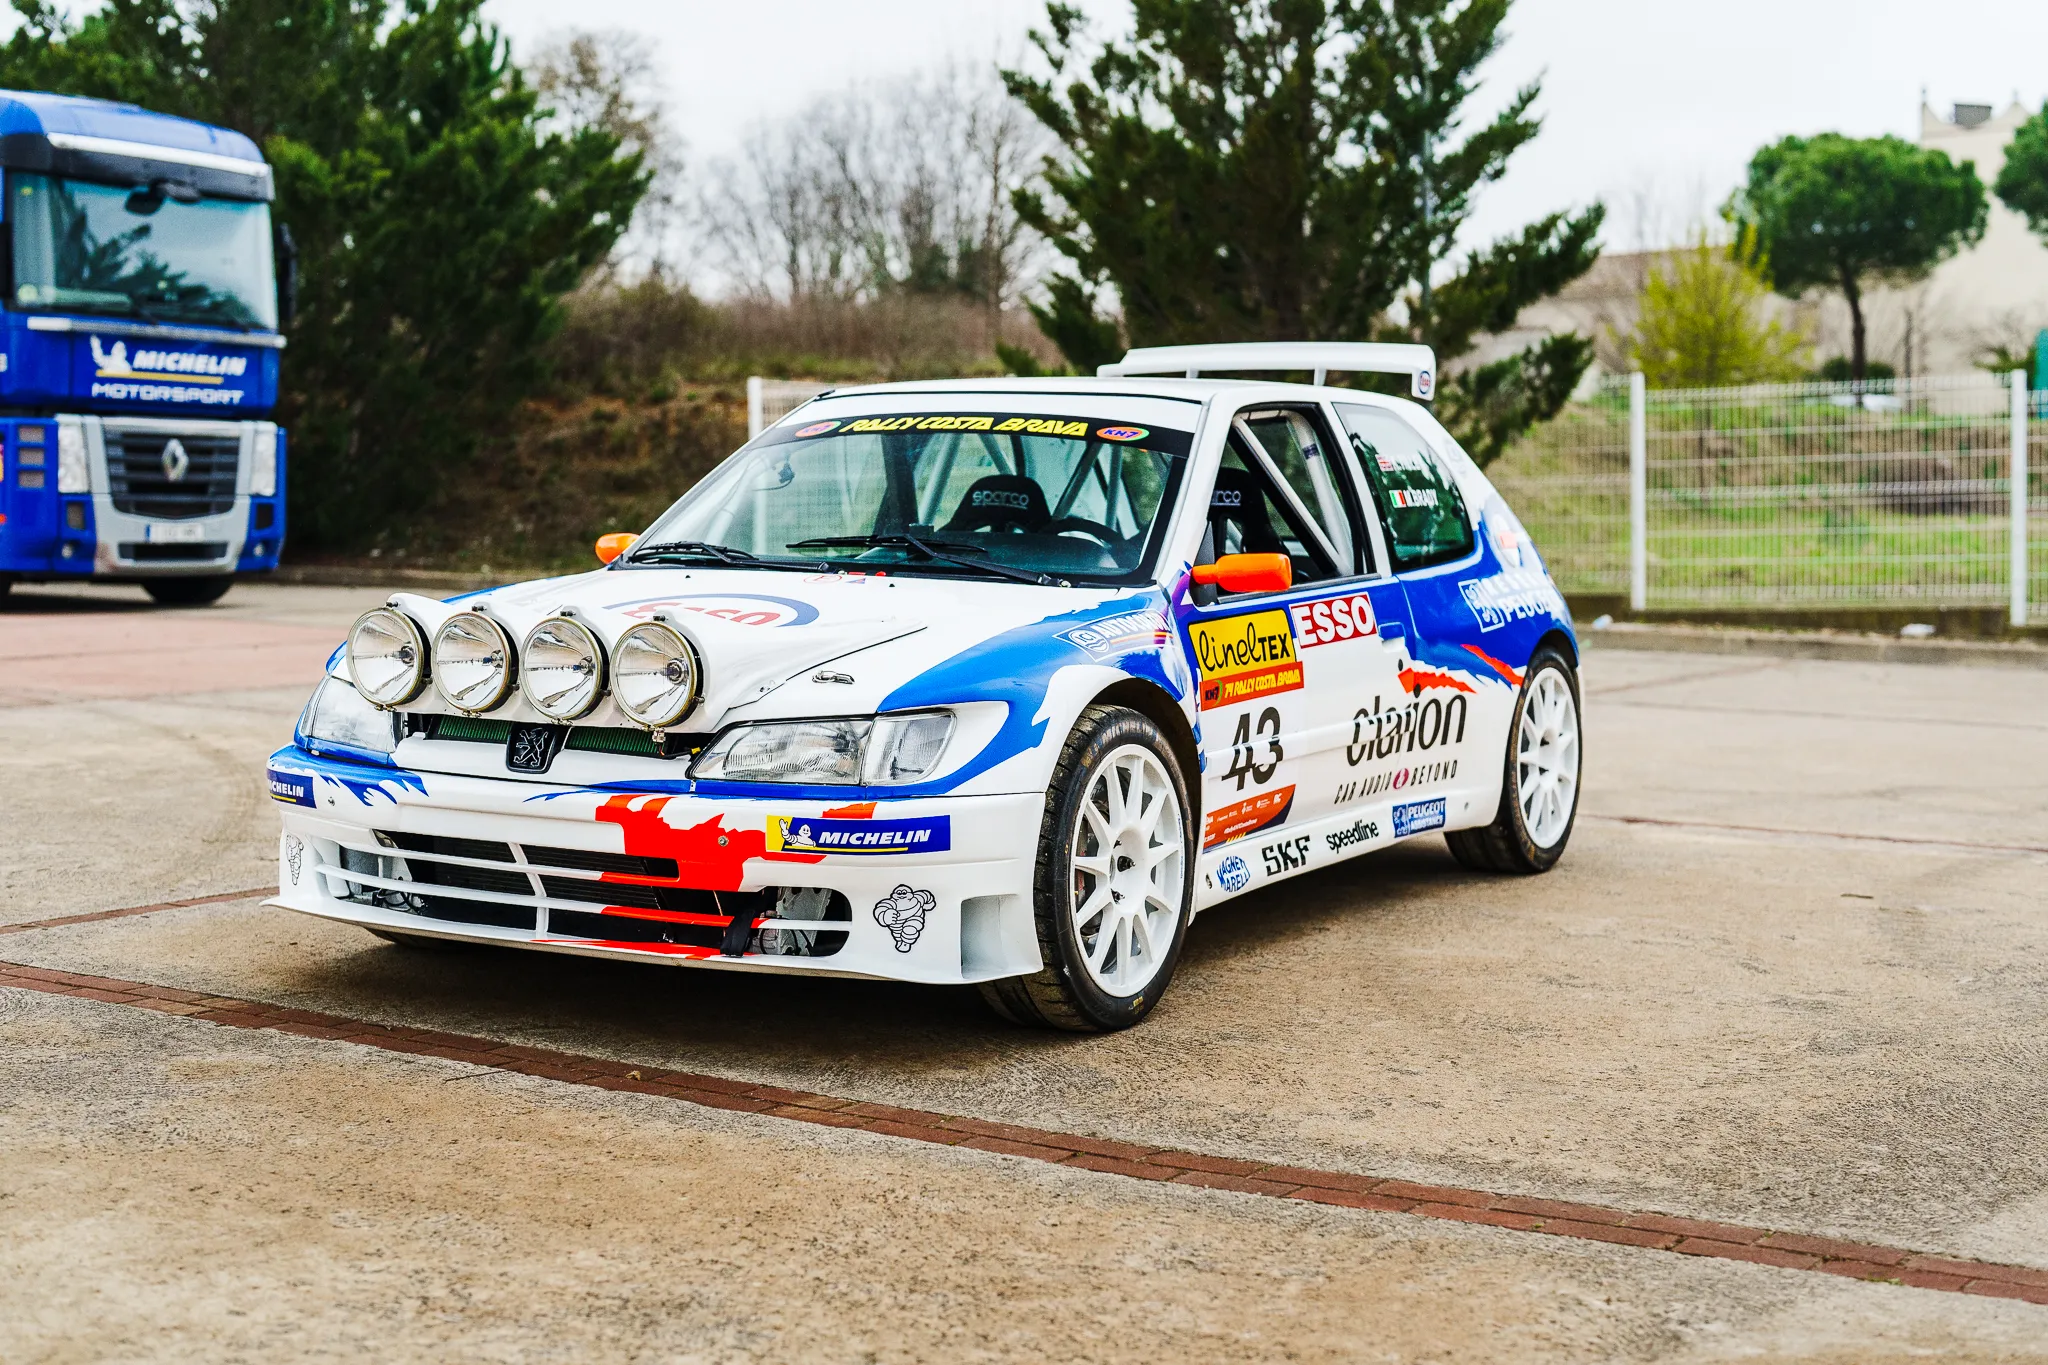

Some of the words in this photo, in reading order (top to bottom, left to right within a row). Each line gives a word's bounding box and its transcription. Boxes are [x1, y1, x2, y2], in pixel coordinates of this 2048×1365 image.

[133, 350, 247, 376] MICHELIN
[91, 382, 244, 405] MOTORSPORT
[839, 417, 924, 432] RALLY
[916, 416, 994, 430] COSTA
[993, 417, 1088, 437] BRAVA
[972, 490, 1029, 506] sparco
[1294, 596, 1376, 646] ESSO
[1233, 677, 1255, 696] RALLY
[1255, 673, 1277, 691] COSTA
[1276, 668, 1301, 686] BRAVA
[1346, 683, 1467, 767] clarion
[1221, 706, 1284, 792] 43
[1334, 781, 1357, 805] CAR
[1359, 771, 1392, 798] AUDIO
[1410, 759, 1458, 786] BEYOND
[1408, 800, 1445, 820] PEUGEOT
[818, 829, 932, 846] MICHELIN
[1326, 820, 1379, 854] speedline
[1262, 835, 1311, 877] SKF
